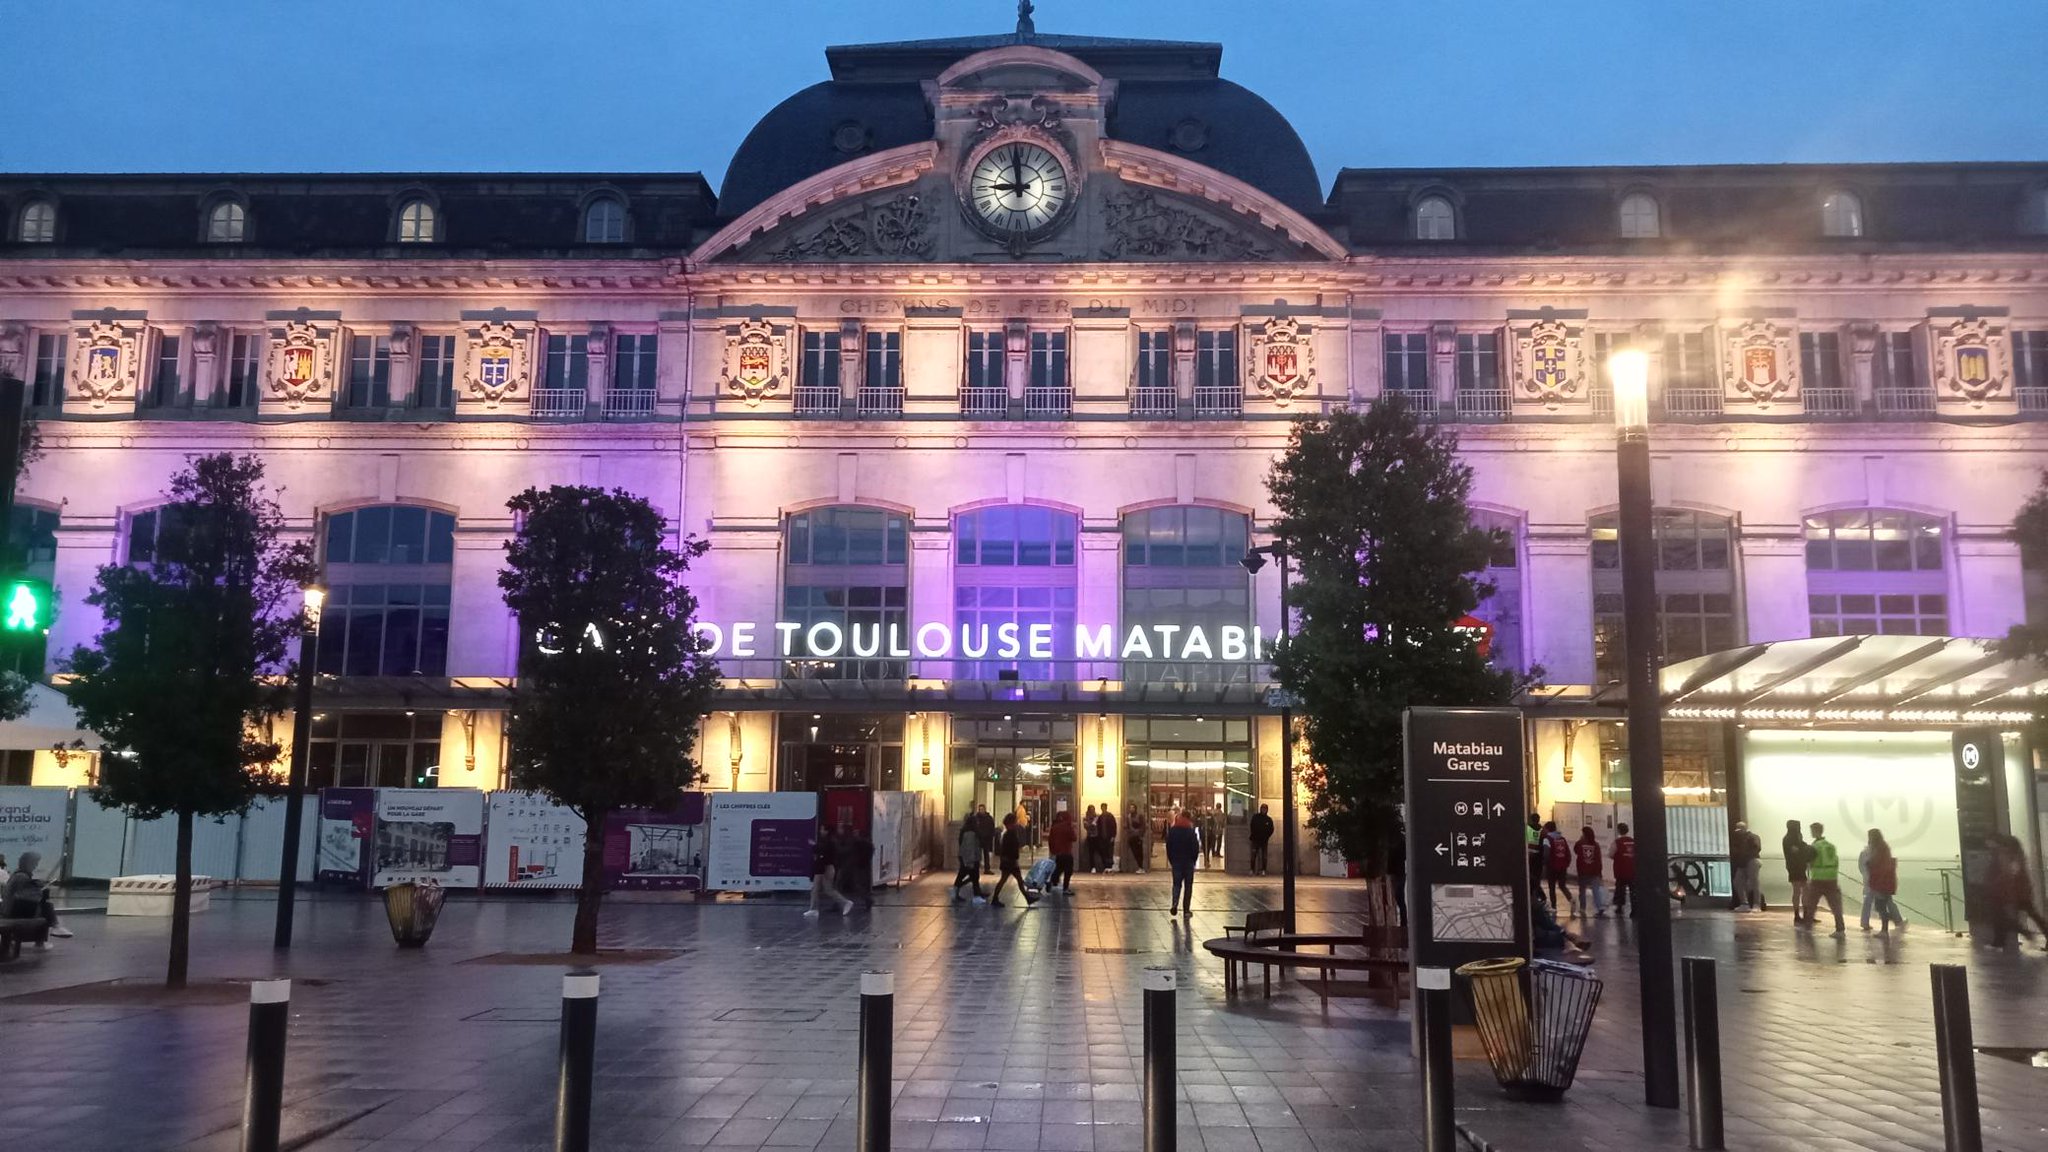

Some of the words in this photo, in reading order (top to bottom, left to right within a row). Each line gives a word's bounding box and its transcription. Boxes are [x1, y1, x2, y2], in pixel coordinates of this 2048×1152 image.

[839, 298, 951, 314] CHEMINS
[968, 298, 1001, 313] DE
[1018, 298, 1070, 314] FER
[1088, 298, 1124, 313] DU
[1142, 298, 1197, 314] MIDI
[693, 622, 756, 656] DE
[775, 622, 1053, 657] TOULOUSE
[1075, 624, 1294, 660] MATABI
[1433, 741, 1503, 756] Matabiau
[1446, 757, 1490, 771] Gares
[0, 804, 31, 813] rand
[730, 802, 757, 810] CHIFFRES
[0, 814, 51, 822] atabiau
